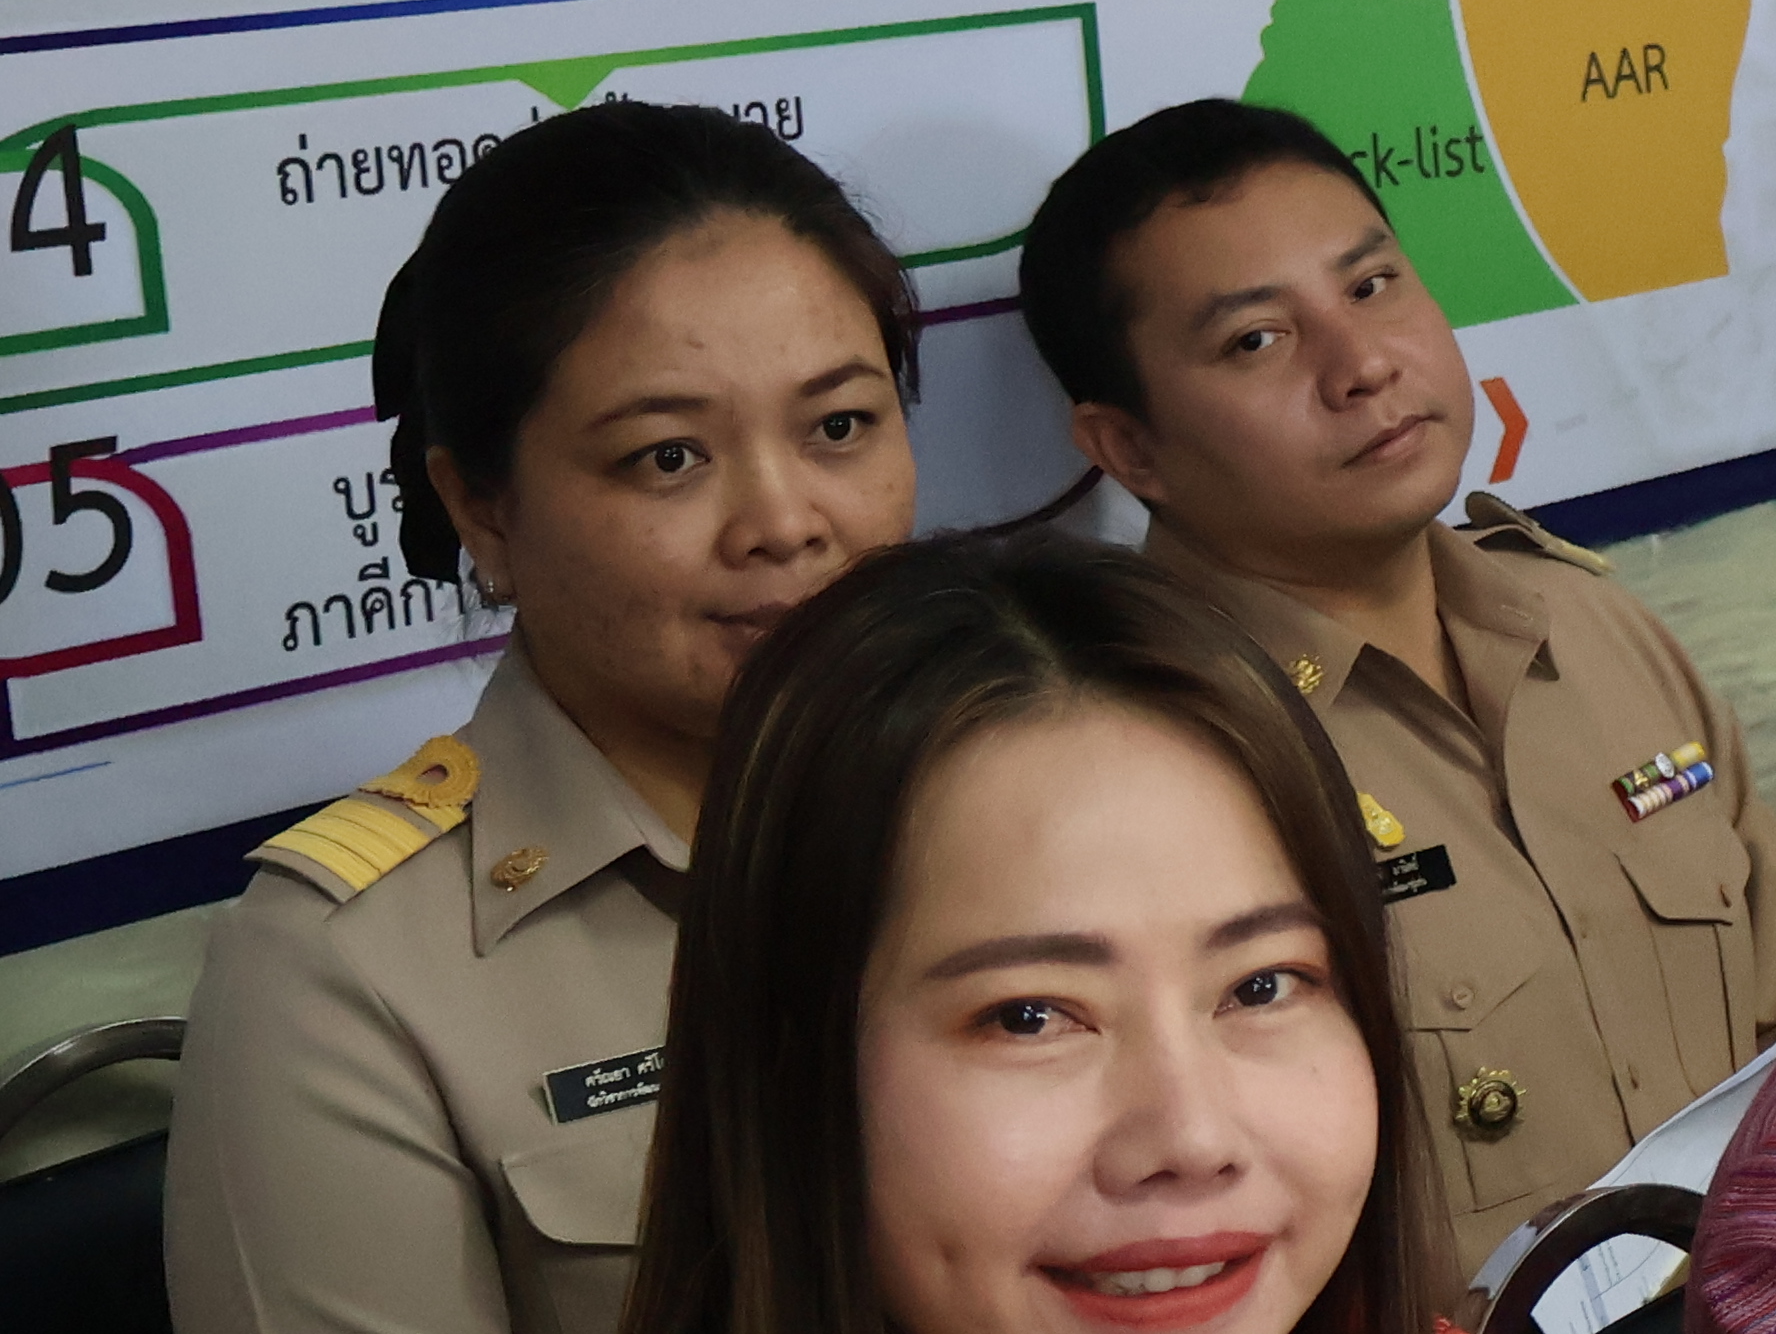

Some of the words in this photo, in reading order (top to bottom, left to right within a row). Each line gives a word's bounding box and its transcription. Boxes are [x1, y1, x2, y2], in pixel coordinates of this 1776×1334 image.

[1579, 42, 1669, 104] AAR
[1350, 124, 1485, 188] k-list
[11, 124, 107, 277] 4
